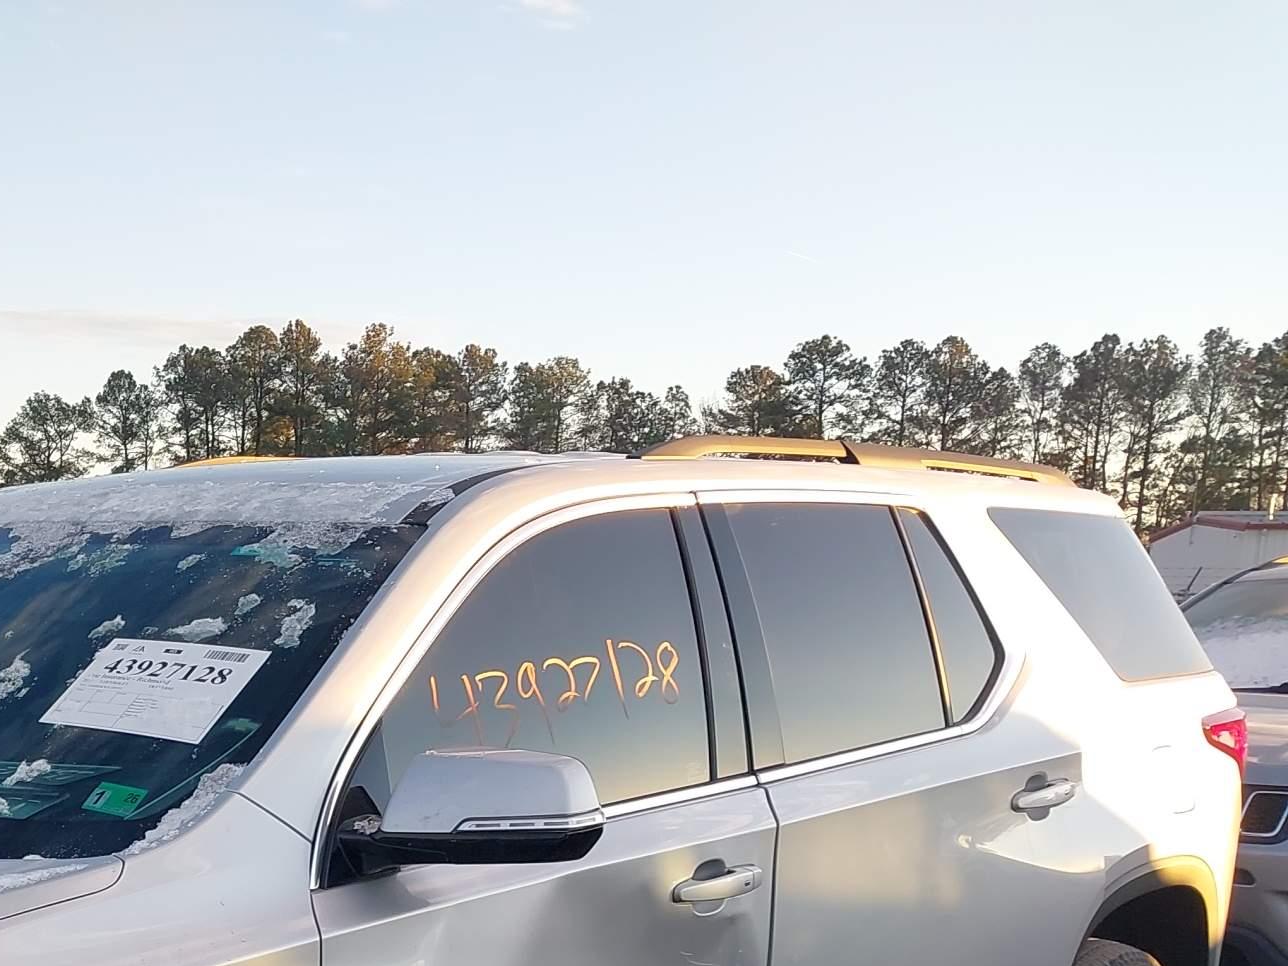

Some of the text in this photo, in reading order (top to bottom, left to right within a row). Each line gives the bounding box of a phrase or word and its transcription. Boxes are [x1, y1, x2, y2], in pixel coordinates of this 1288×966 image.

[103, 658, 233, 685] 43927128
[428, 638, 680, 748] 43927128
[92, 790, 107, 805] 1
